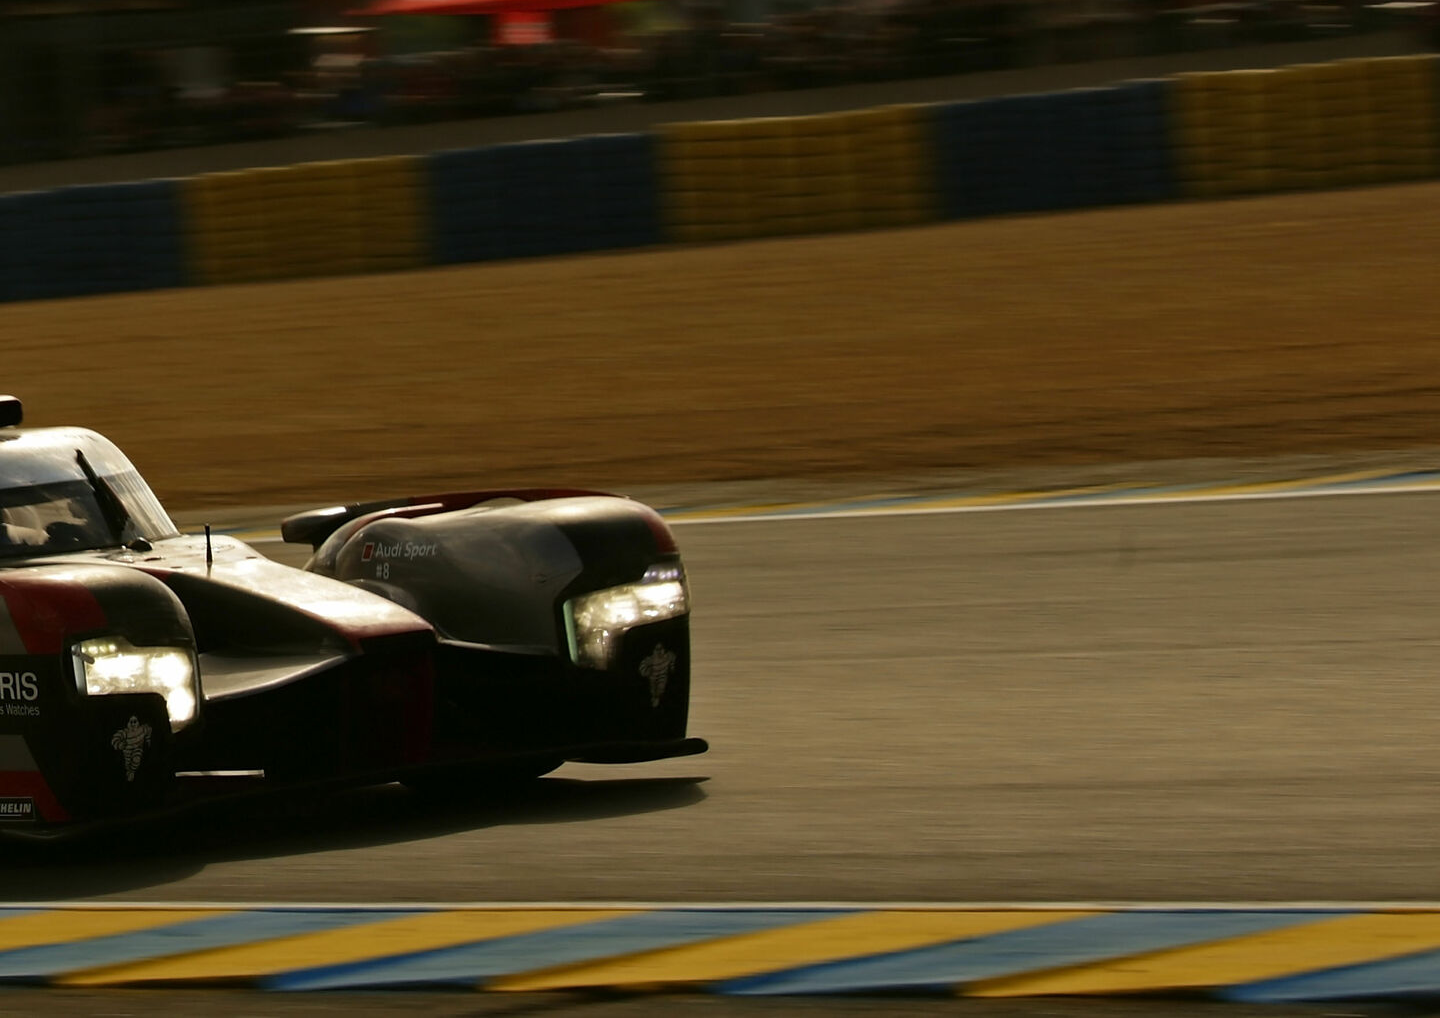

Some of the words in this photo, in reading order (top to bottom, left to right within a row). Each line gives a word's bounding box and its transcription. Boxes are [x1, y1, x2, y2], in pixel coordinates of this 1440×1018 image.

[375, 542, 401, 558] Audi
[404, 542, 437, 561] Sport
[376, 562, 390, 580] #8
[6, 703, 40, 717] Watches
